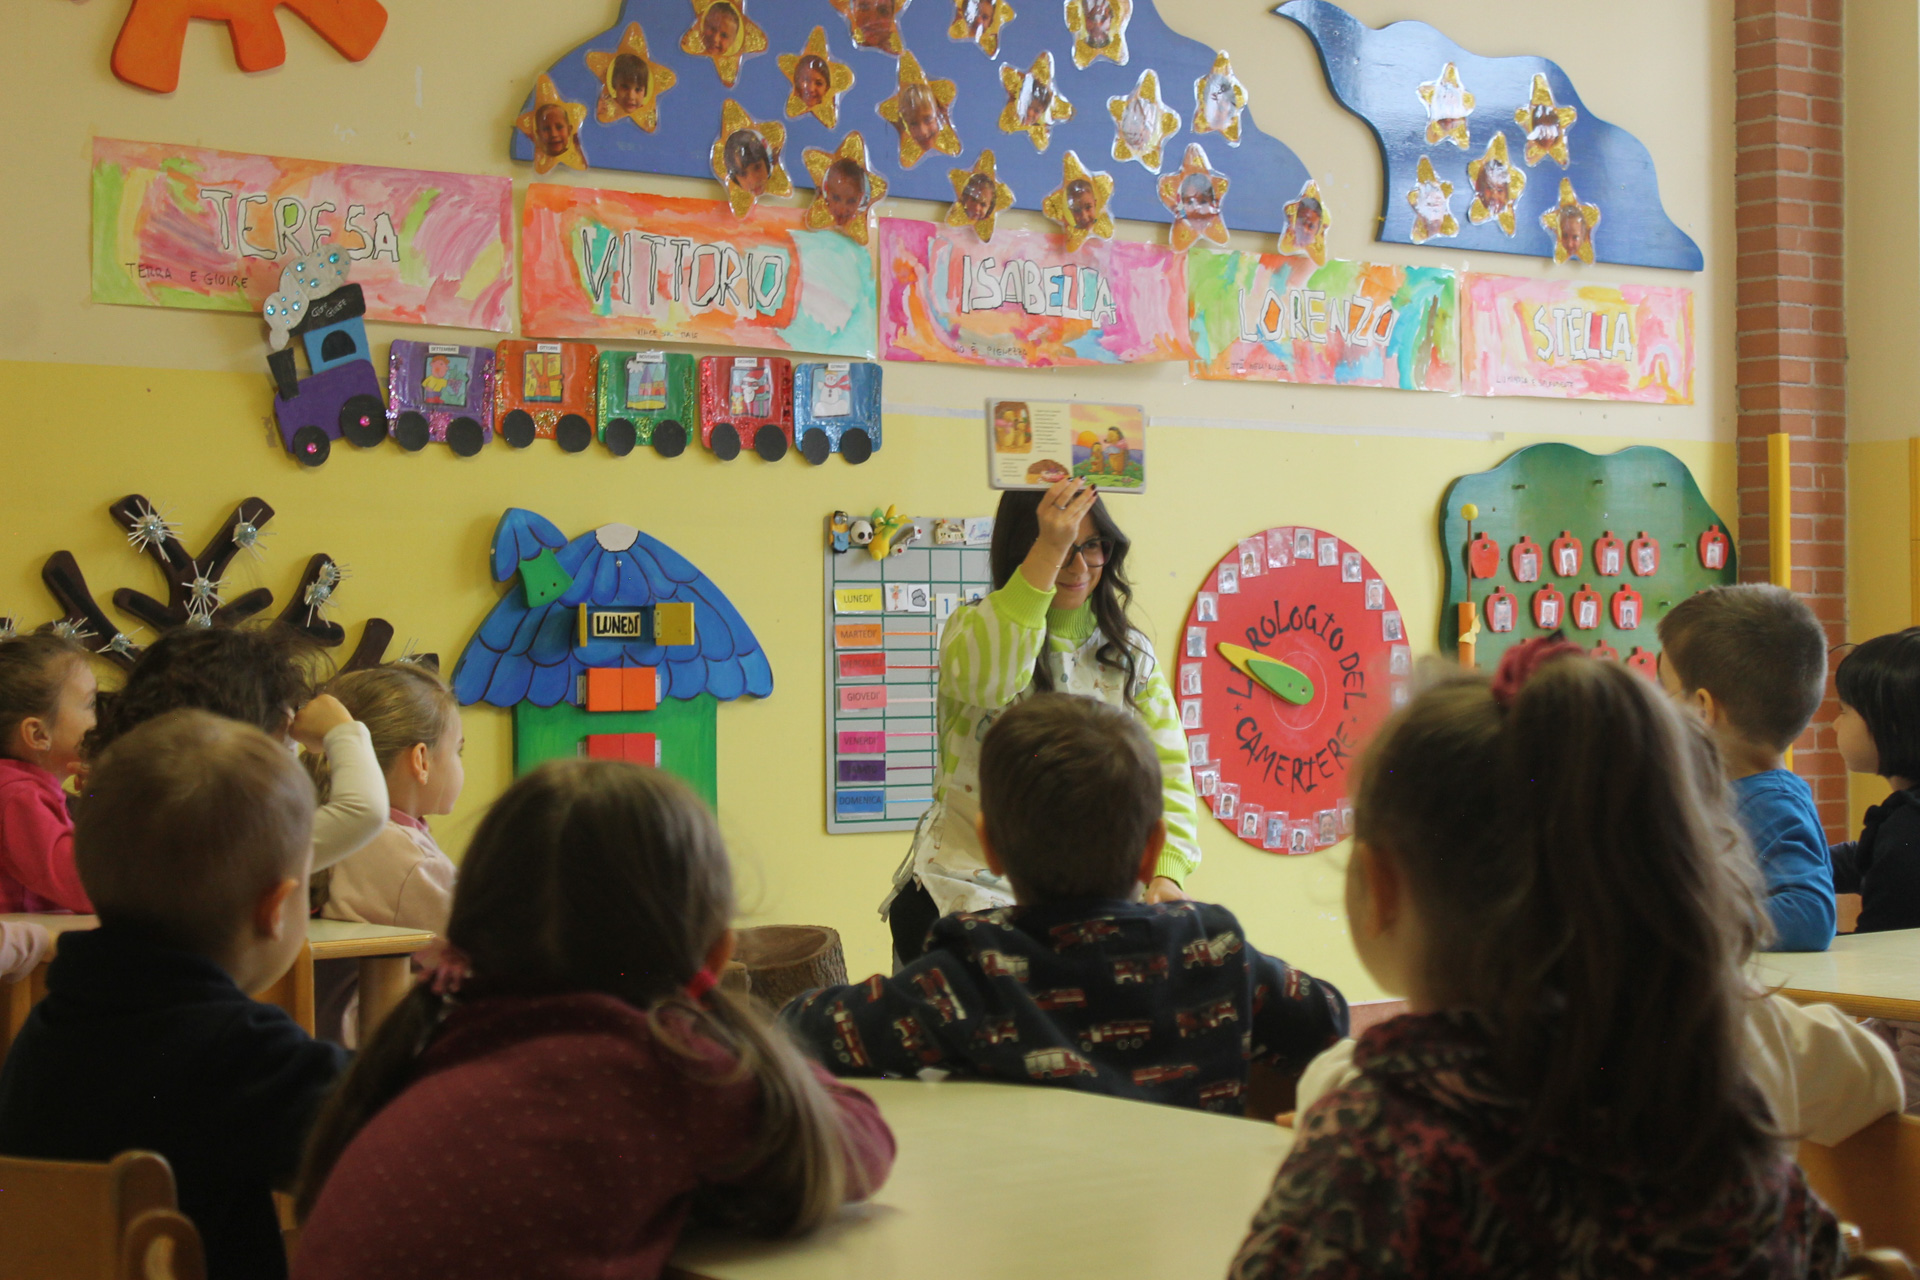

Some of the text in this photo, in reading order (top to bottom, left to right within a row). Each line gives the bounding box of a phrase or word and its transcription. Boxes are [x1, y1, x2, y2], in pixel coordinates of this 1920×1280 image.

[200, 189, 400, 262] TERESA
[125, 263, 248, 288] TERRA E GIOIRE
[582, 228, 783, 309] VITTORIO
[961, 255, 1117, 328] ISABELLA
[1238, 289, 1394, 347] LORENZO
[1533, 305, 1633, 361] STELLA
[943, 598, 949, 614] 1
[1338, 652, 1368, 710] DEL
[839, 795, 882, 805] DOMENICA
